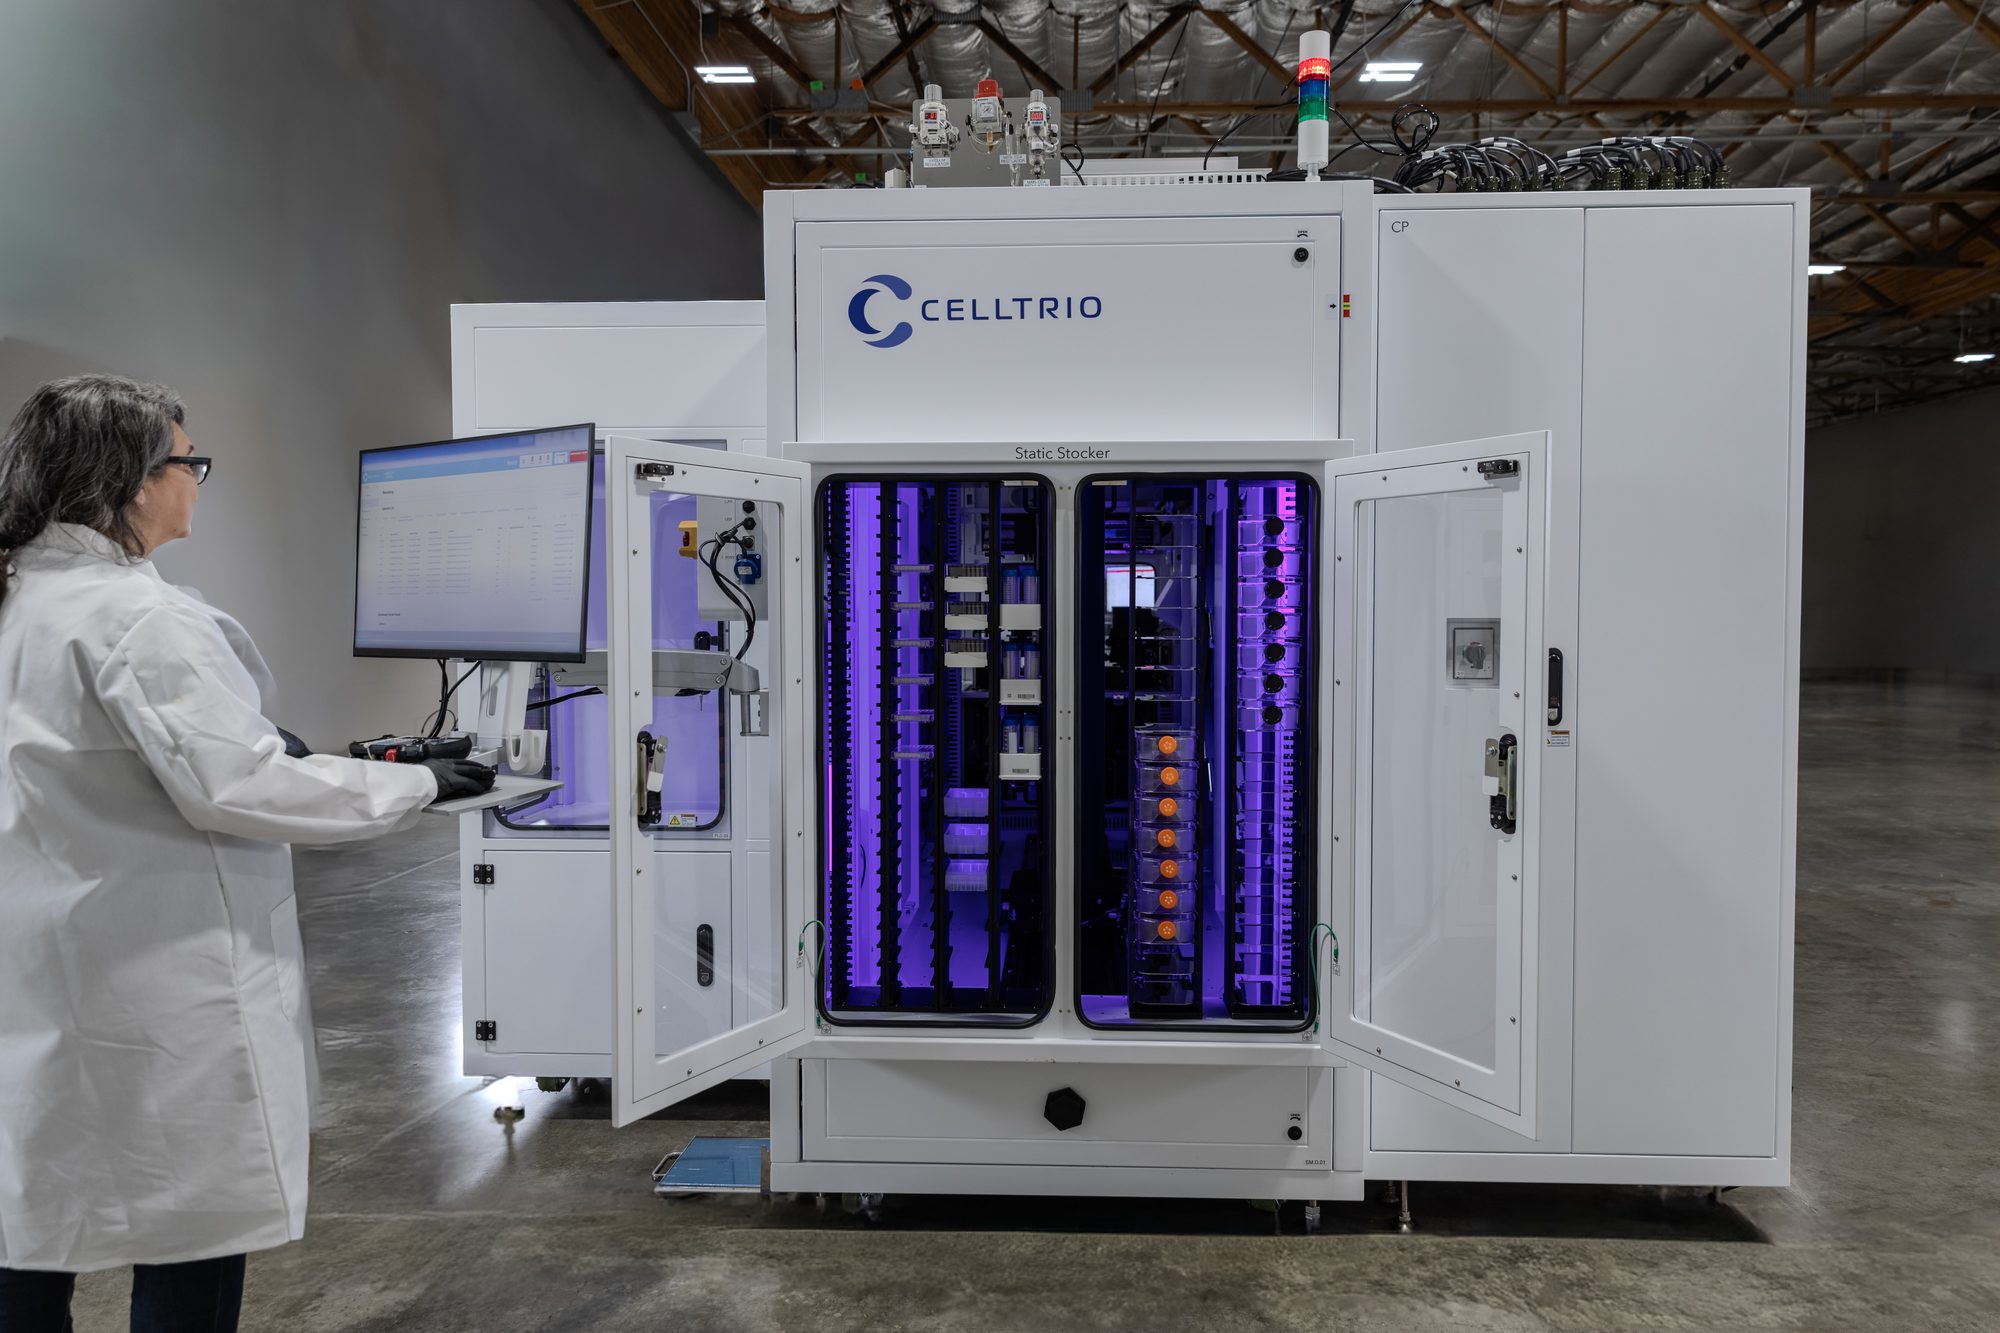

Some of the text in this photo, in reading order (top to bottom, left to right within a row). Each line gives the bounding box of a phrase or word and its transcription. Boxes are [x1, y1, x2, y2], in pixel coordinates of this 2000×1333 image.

[1391, 220, 1410, 233] CP
[921, 296, 1102, 321] CELLTRIO
[1015, 445, 1110, 459] Static Stocker
